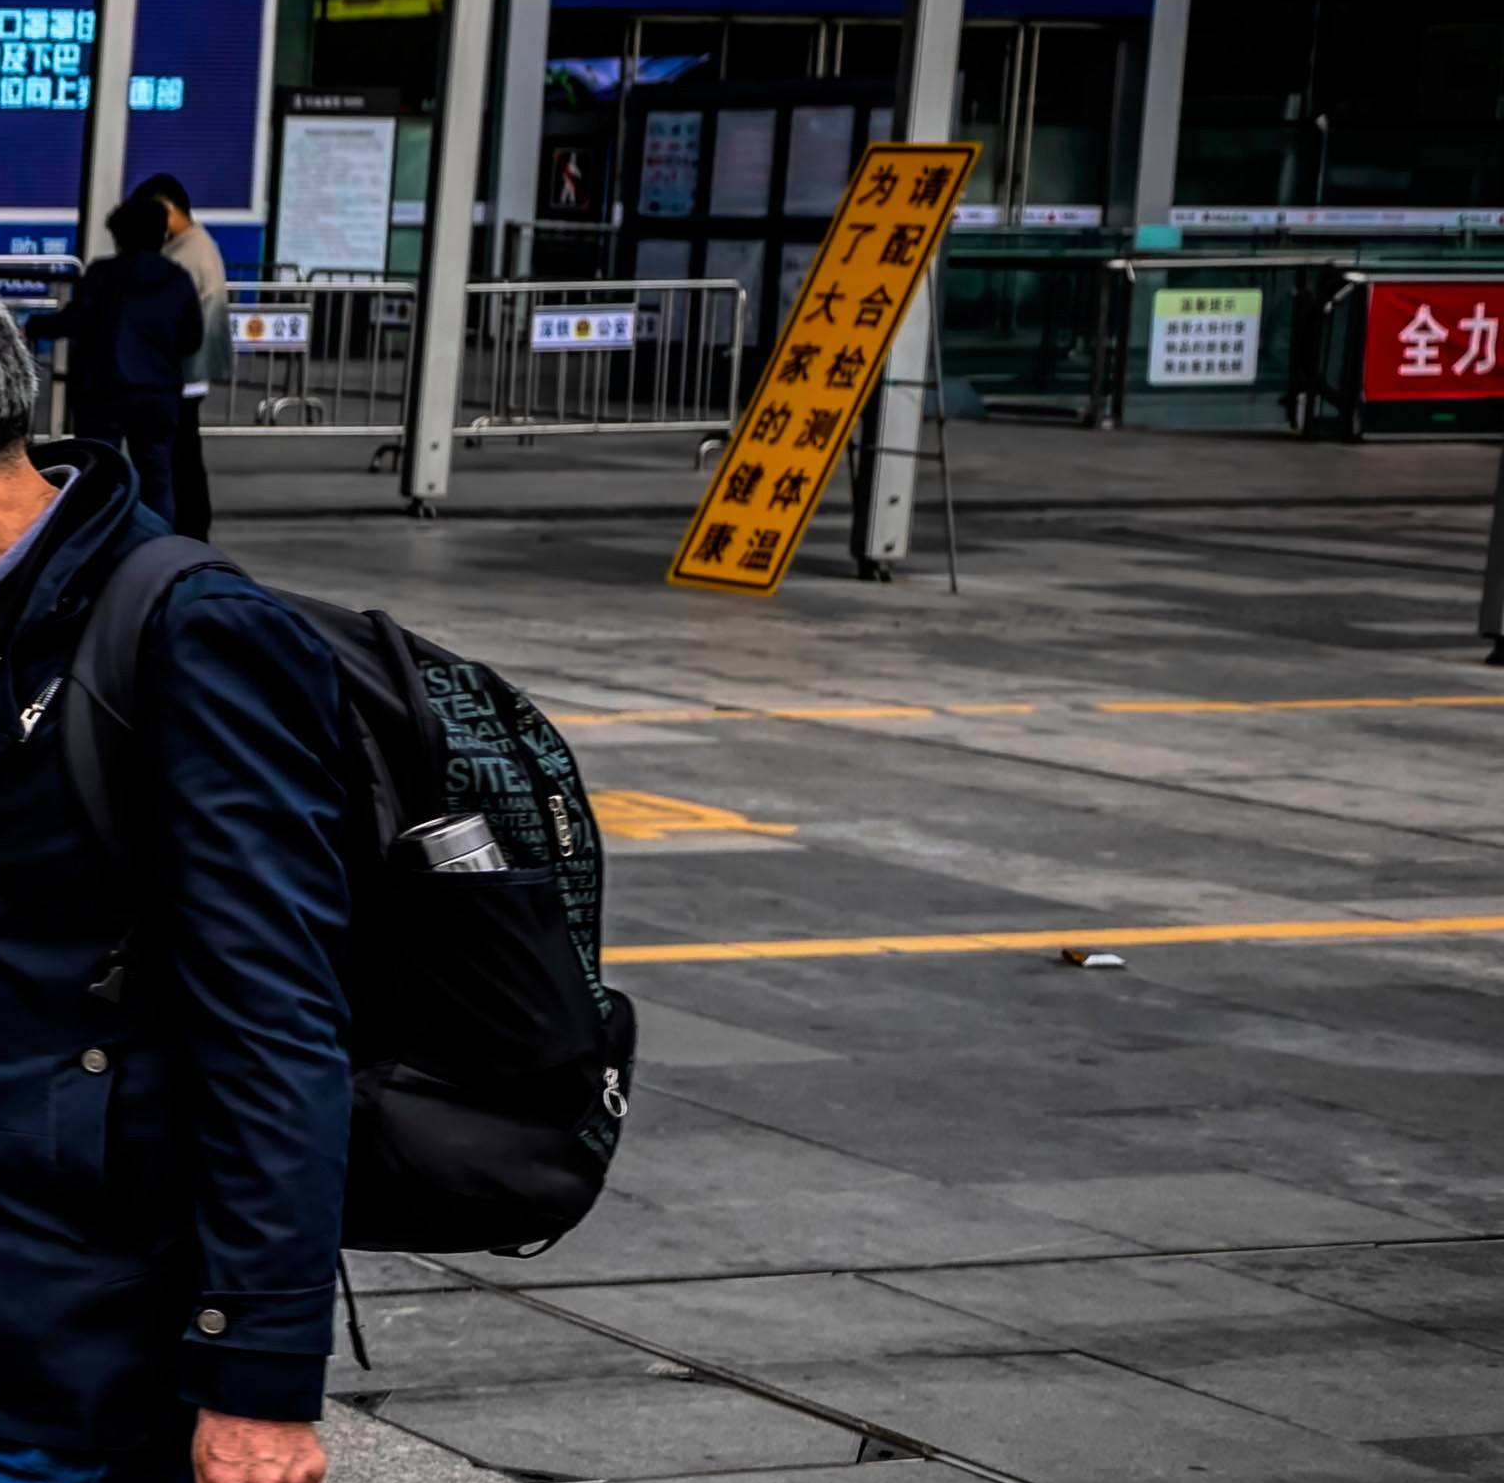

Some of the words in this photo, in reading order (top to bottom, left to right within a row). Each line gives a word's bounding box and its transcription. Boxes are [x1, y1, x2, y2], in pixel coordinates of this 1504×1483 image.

[692, 164, 897, 568] 为了大家的健康
[737, 164, 953, 573] 请配合检测体温
[1396, 301, 1500, 378] 全力
